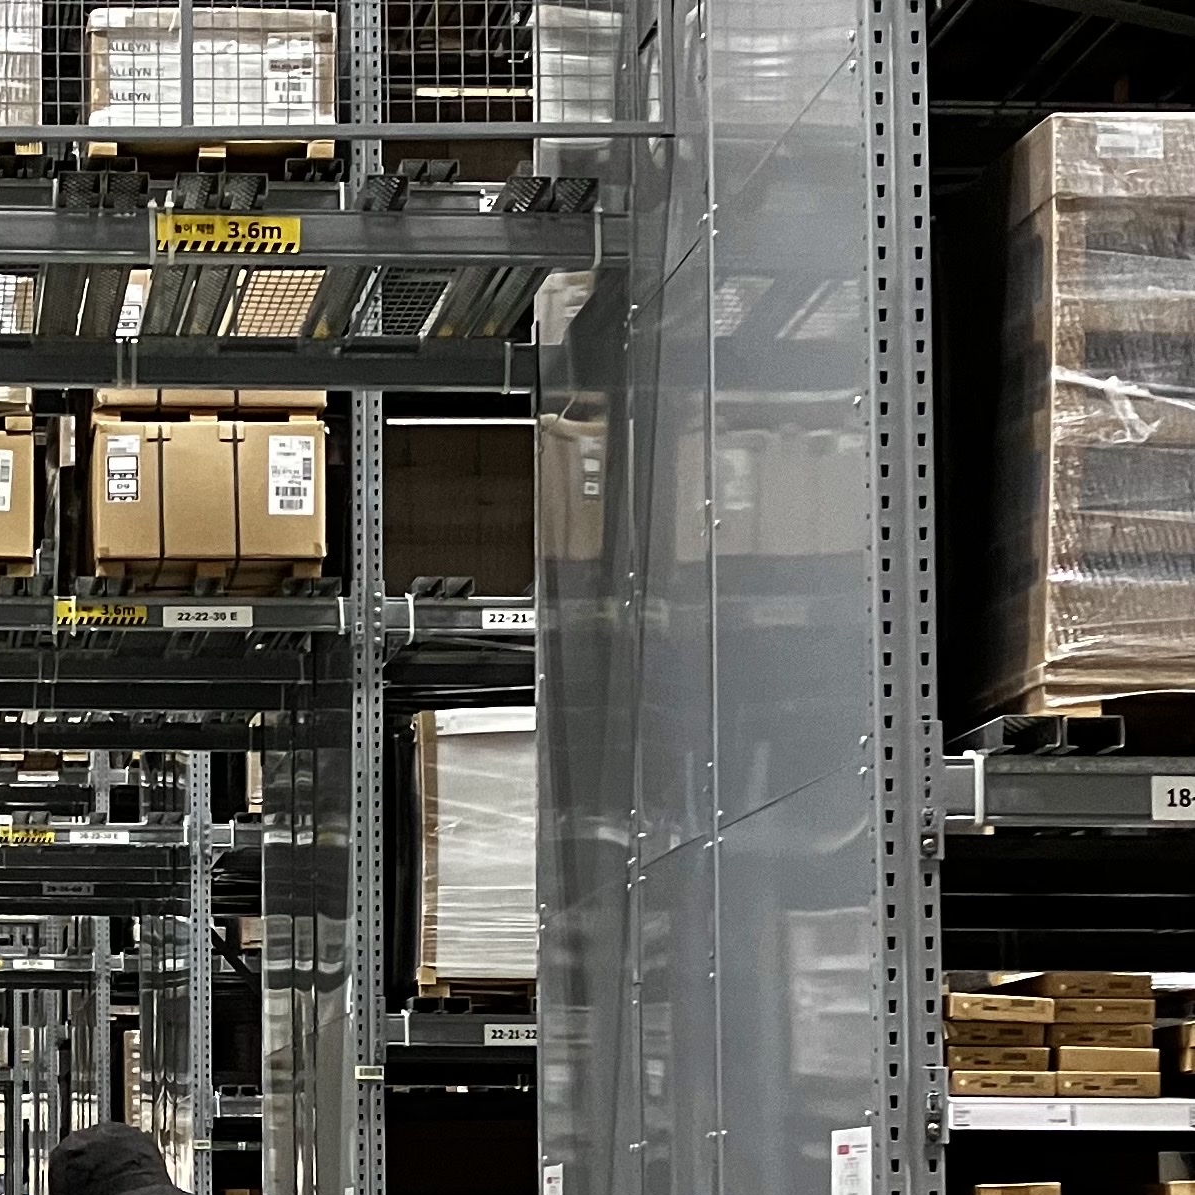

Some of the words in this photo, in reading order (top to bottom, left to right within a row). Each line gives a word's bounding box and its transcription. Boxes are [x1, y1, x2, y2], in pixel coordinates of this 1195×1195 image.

[227, 221, 282, 239] 3.6m
[177, 612, 227, 621] 22-22-30
[230, 611, 238, 621] E
